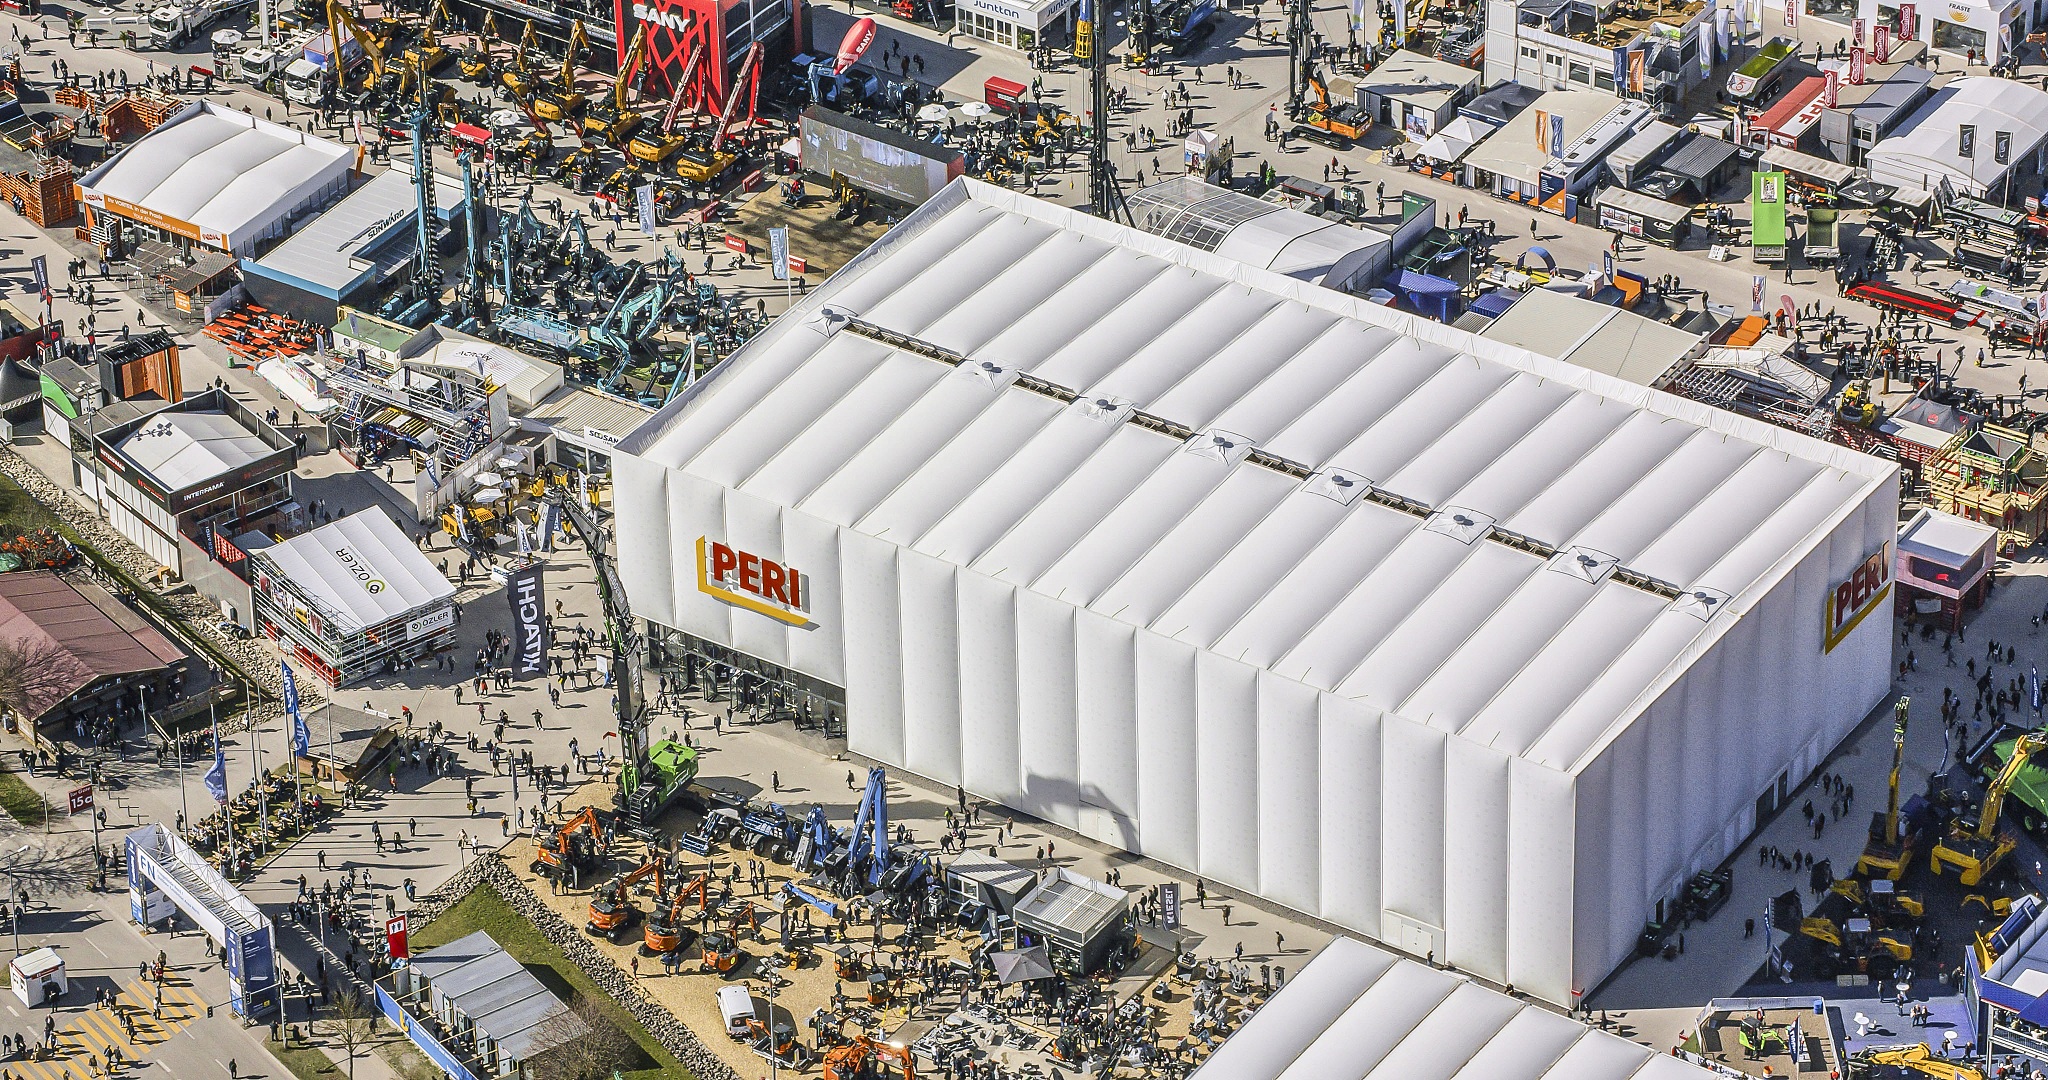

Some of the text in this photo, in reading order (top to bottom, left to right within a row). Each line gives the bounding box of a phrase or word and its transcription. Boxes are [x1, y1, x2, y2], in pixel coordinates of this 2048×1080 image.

[633, 3, 691, 32] SANY
[974, 0, 1019, 19] Junttan
[1949, 2, 1971, 13] FRASTE
[856, 29, 873, 54] SANY
[368, 209, 405, 240] SUNWARD
[183, 481, 225, 501] INTERFAMA
[335, 548, 370, 581] ÖZLER
[712, 541, 802, 609] PERI
[1836, 540, 1890, 628] PERI
[422, 611, 449, 626] ÖZLER
[70, 795, 93, 809] 15a
